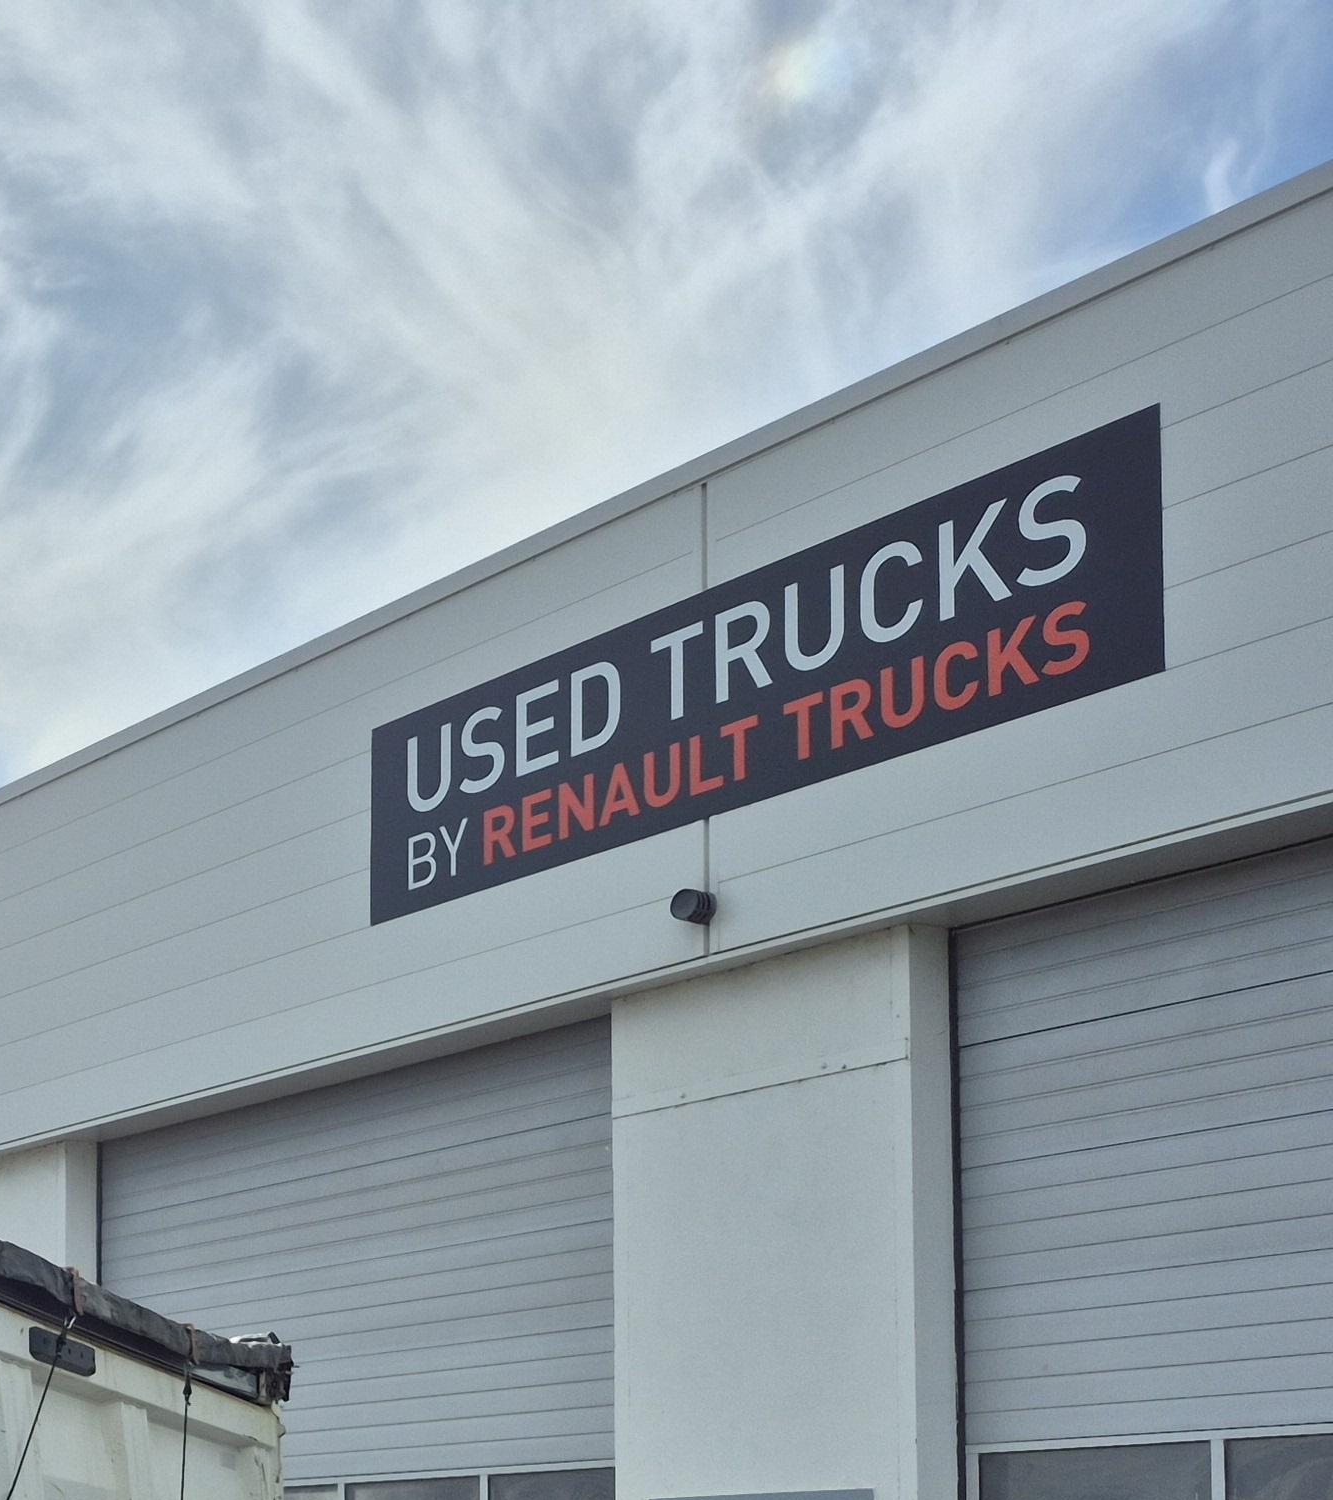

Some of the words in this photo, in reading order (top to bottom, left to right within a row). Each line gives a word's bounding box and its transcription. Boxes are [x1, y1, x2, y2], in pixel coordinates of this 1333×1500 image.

[406, 661, 622, 813] USED
[650, 475, 1088, 720] TRUCKS
[406, 816, 469, 891] BY
[482, 713, 761, 866] RENAULT
[782, 600, 1091, 761] TRUCKS
